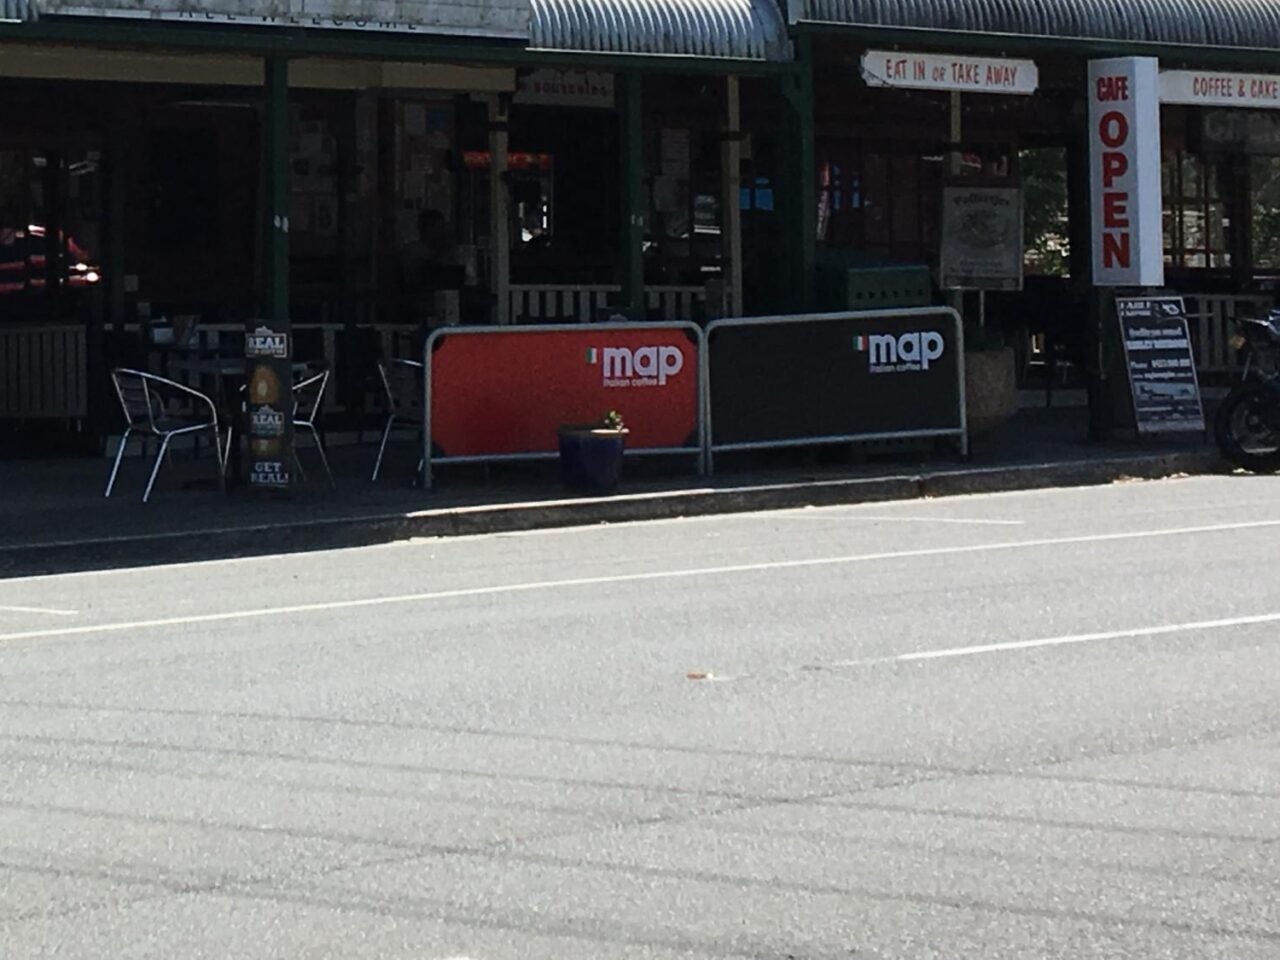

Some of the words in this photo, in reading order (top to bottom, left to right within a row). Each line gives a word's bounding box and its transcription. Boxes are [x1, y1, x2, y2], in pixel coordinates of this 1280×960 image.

[886, 59, 907, 79] EAT
[913, 60, 925, 80] IN
[951, 63, 979, 84] TAKE
[985, 65, 1018, 86] AWAY
[1096, 76, 1128, 101] CAFE
[1193, 77, 1233, 97] COFFEE
[1238, 79, 1245, 97] &
[1250, 79, 1277, 99] CAKE
[1099, 111, 1130, 268] OPEN
[603, 346, 683, 385] map
[869, 331, 944, 370] map
